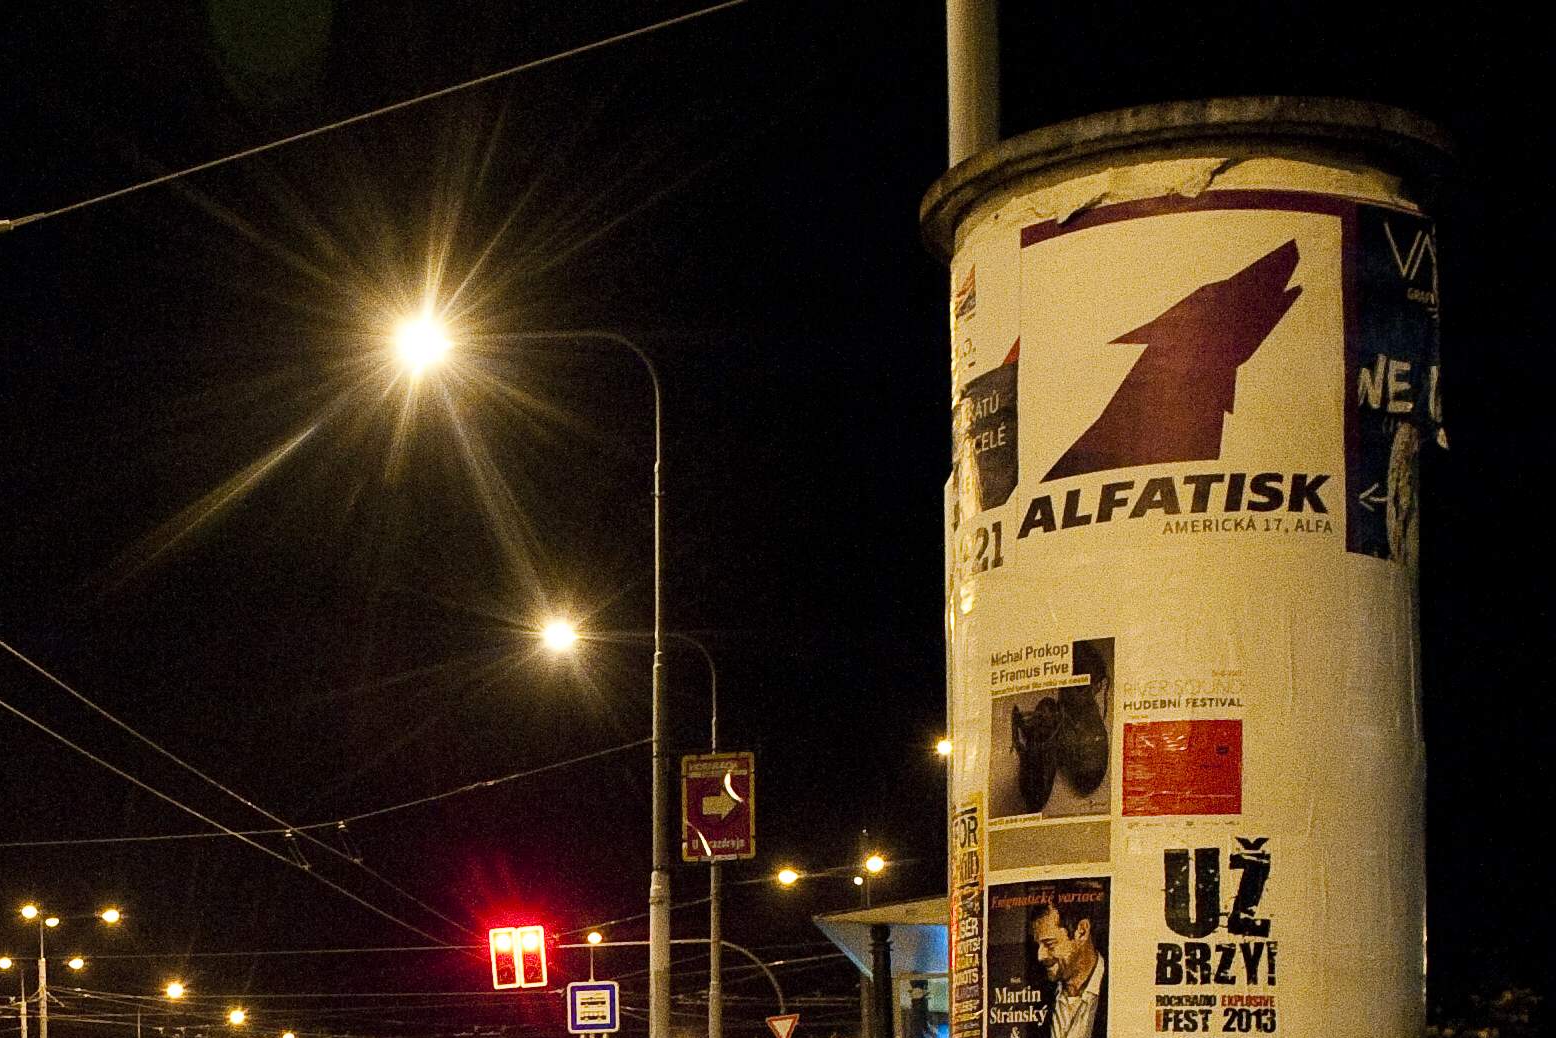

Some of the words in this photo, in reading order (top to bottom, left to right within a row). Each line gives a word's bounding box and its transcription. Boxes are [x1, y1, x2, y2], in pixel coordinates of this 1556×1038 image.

[1016, 472, 1331, 540] ALFATISK
[1162, 516, 1256, 534] AMERICKÁ
[1263, 518, 1289, 533] 17,
[1294, 519, 1333, 533] ALFA
[991, 647, 1023, 666] Michal
[1025, 643, 1069, 660] Prokop
[999, 667, 1041, 683] Framus
[1044, 661, 1069, 676] Five
[1123, 695, 1181, 711] HUDEBNÍ
[1185, 697, 1243, 708] FESTIVAL
[1163, 837, 1271, 938] UŽ
[1155, 941, 1278, 986] BRZY!
[994, 986, 1042, 1004] Martin
[989, 1004, 1049, 1026] Stránský
[1162, 1009, 1212, 1032] FEST
[1222, 1008, 1277, 1033] 2013
